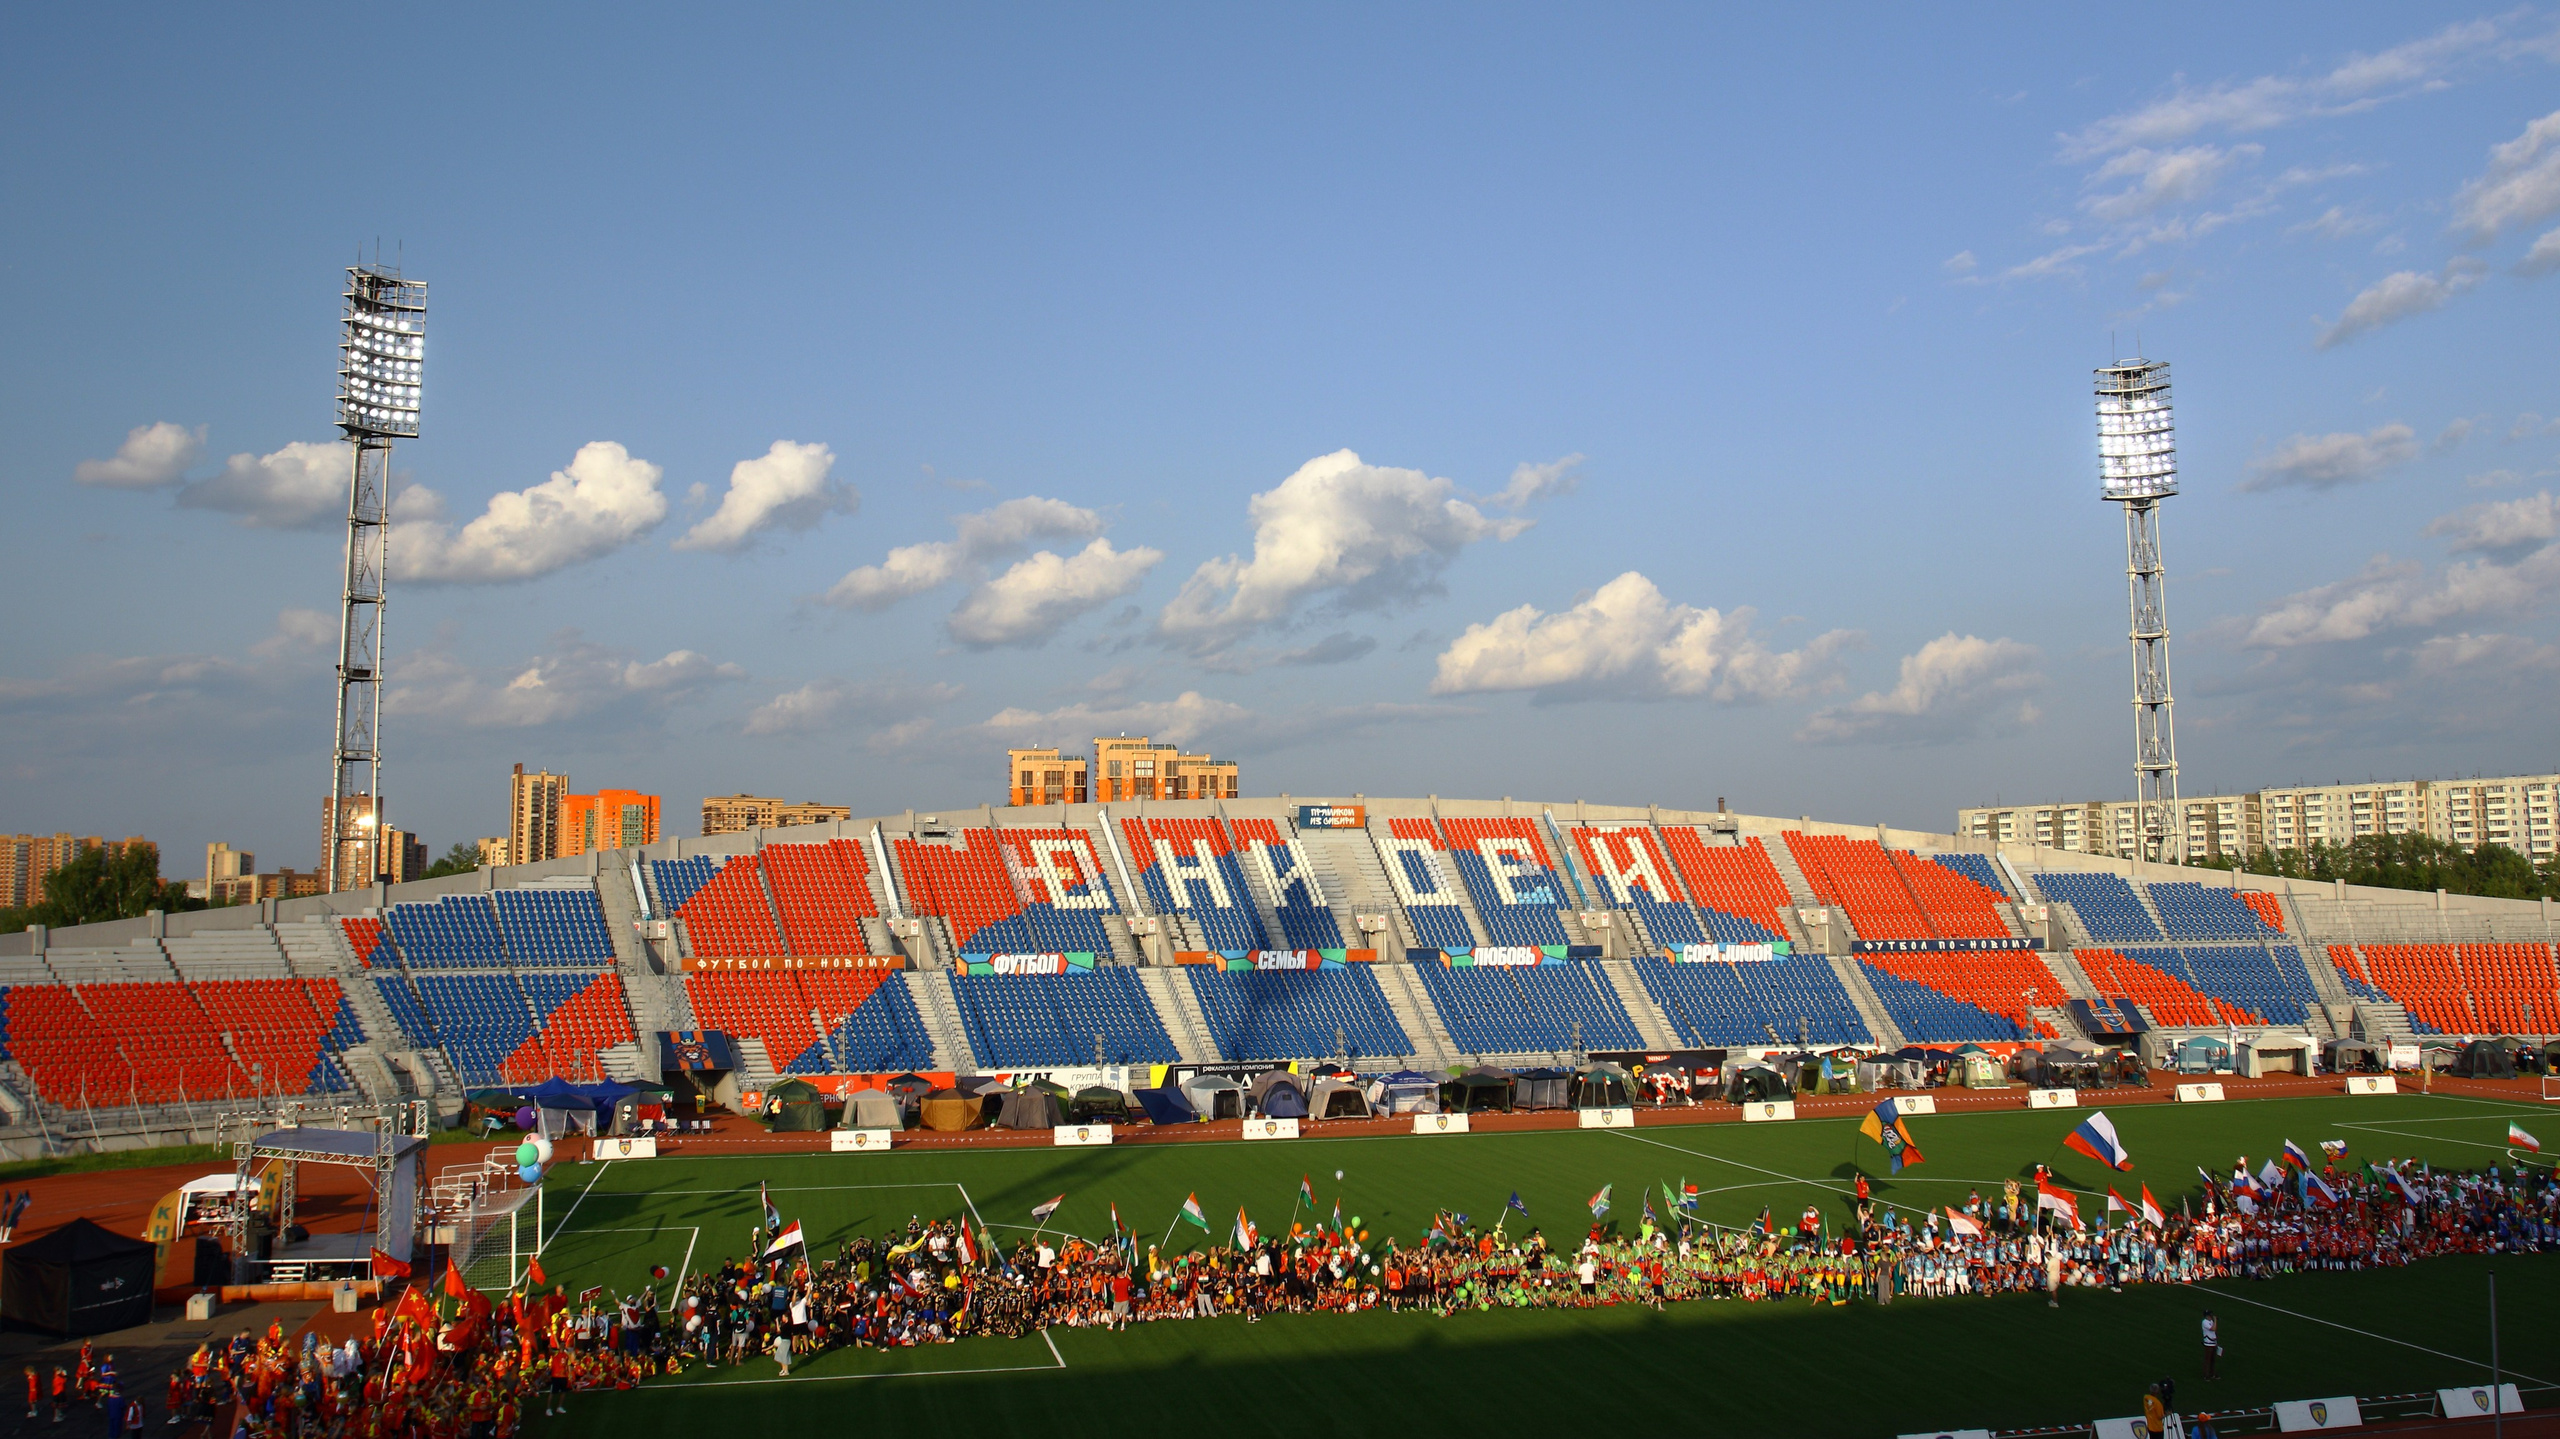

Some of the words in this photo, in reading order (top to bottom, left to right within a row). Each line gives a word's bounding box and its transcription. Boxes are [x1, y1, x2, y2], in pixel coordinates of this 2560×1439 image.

[1310, 808, 1355, 817] ПРЯМИКОМ
[1310, 817, 1322, 825] ИЗ
[1323, 817, 1355, 825] СИБИРИ
[1864, 941, 1929, 951] ФУТБОЛ
[1938, 938, 2033, 950] ПО-НОВОМУ
[1473, 947, 1535, 966] ЛЮБОВЬ
[1683, 944, 1719, 963] COPA
[1721, 943, 1773, 962] JUNIOR
[697, 958, 771, 969] ФУТБОЛ
[784, 957, 891, 969] ПО-НОВОМУ
[993, 954, 1059, 974] ФУТБОЛ
[1258, 950, 1307, 970] СЕМЬЯ
[1203, 1065, 1240, 1073] рекламная
[1071, 1073, 1102, 1081] ГРУППА
